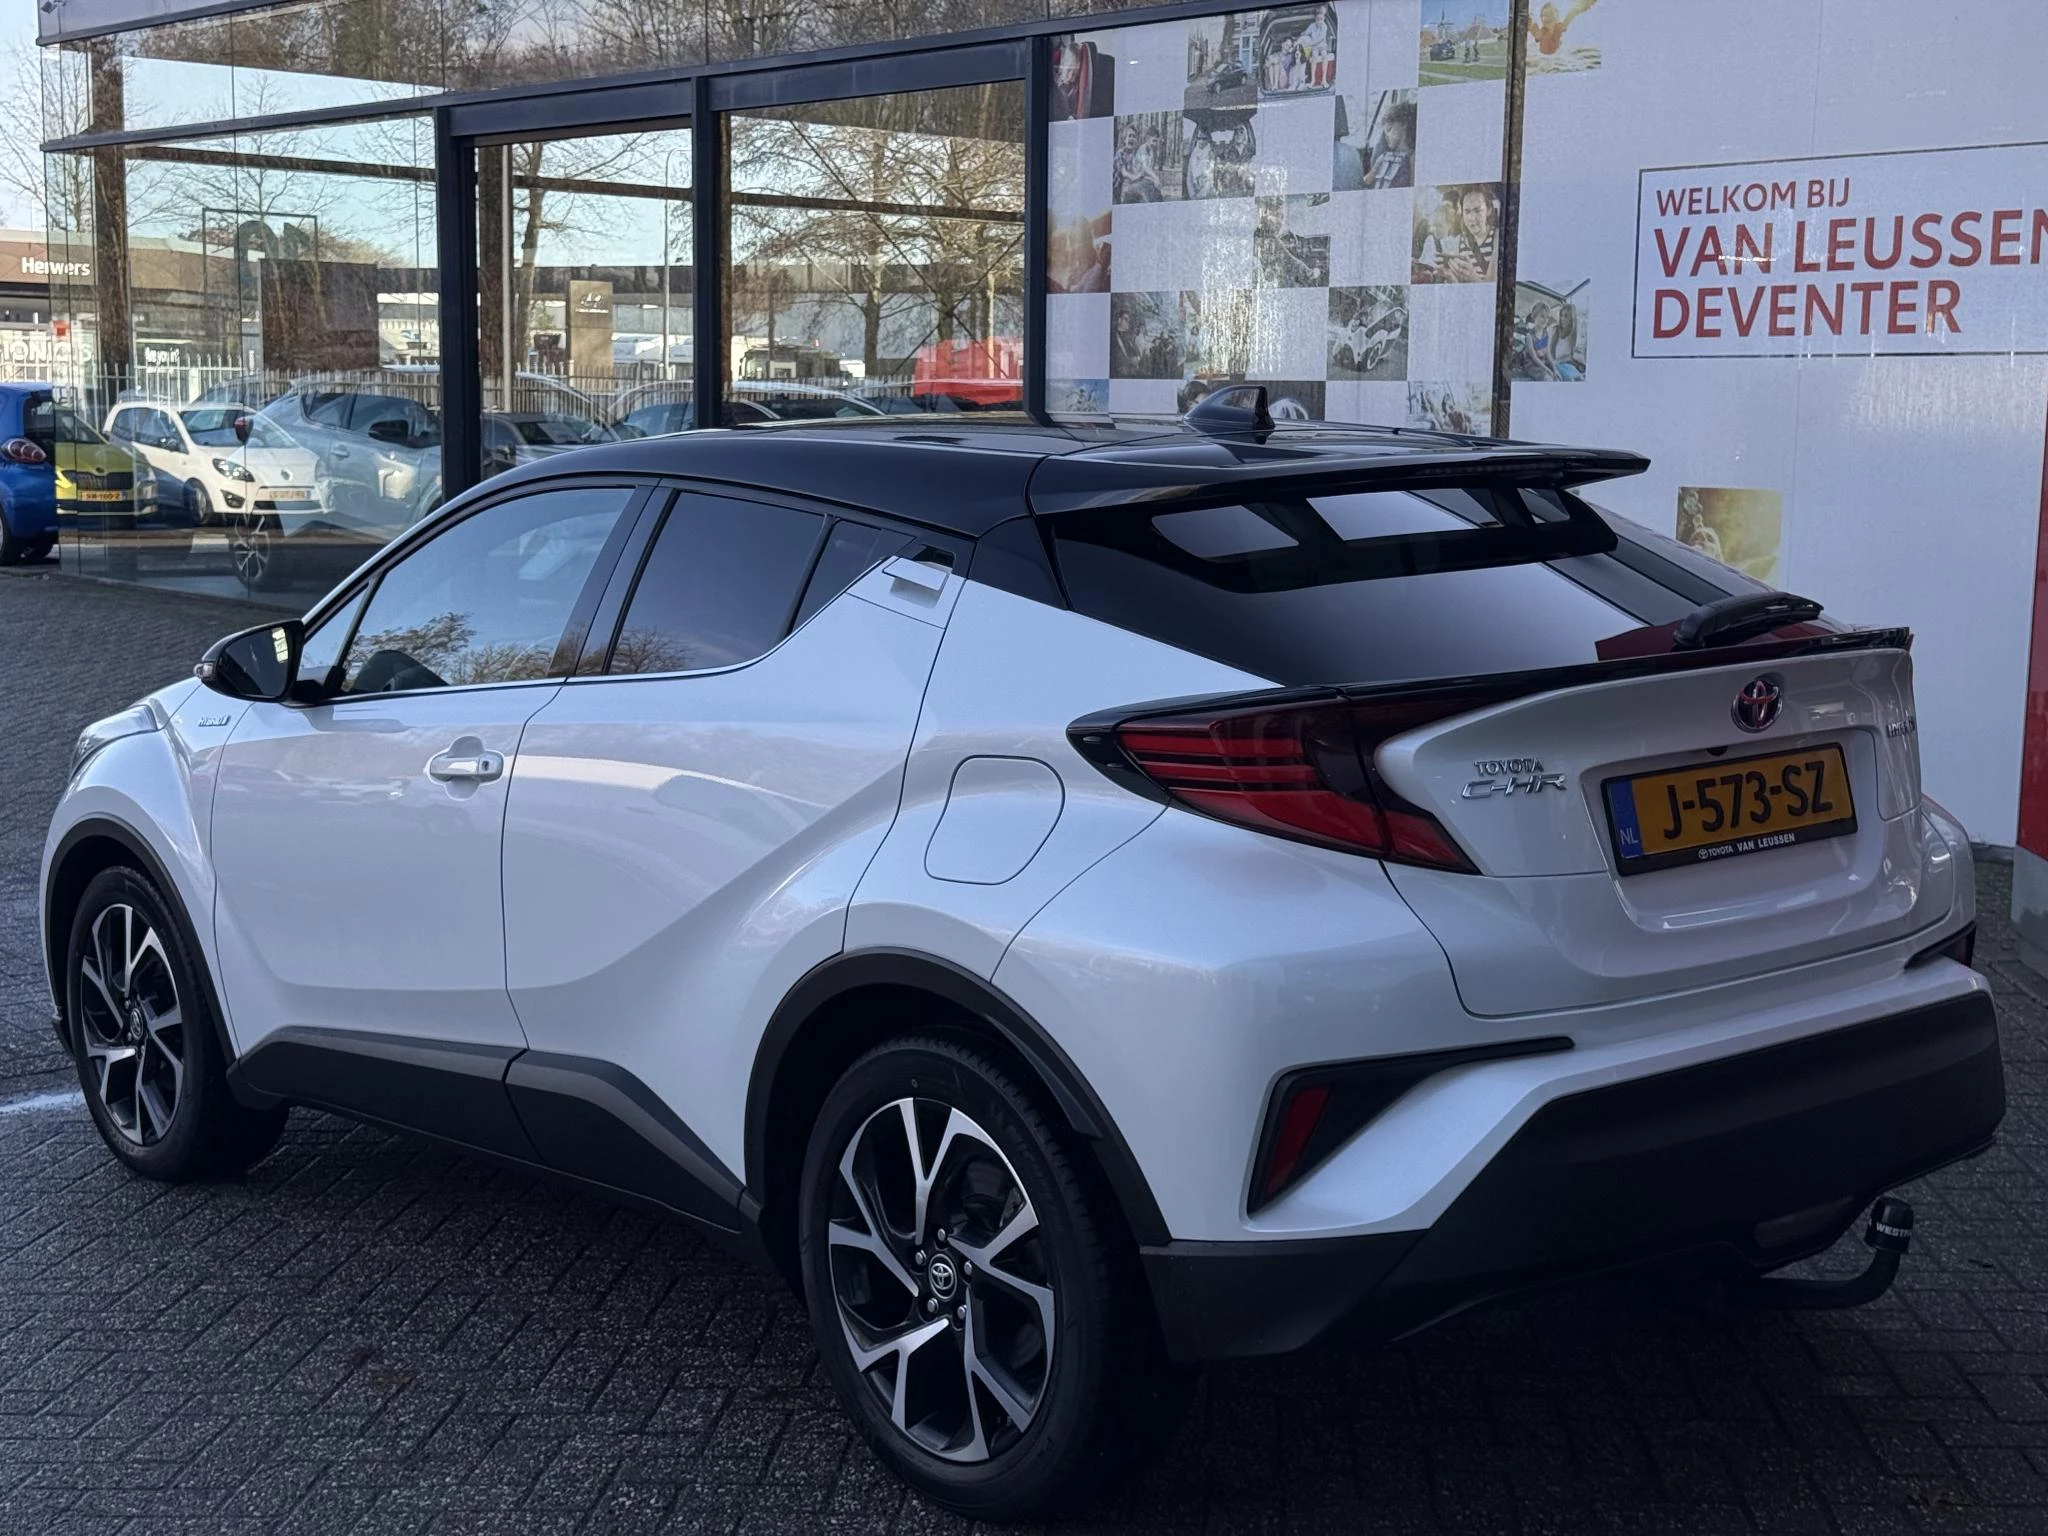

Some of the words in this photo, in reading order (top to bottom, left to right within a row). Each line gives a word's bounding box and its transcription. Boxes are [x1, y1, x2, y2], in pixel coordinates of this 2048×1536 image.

[1656, 181, 1796, 216] WELKOM
[1806, 177, 1850, 208] BIJ
[1654, 222, 1774, 278] VAN
[1653, 279, 1962, 339] DEVENTER
[1474, 757, 1544, 776] TOYOTA
[1461, 773, 1567, 800] C-HR
[1663, 760, 1833, 840] J-573-SZ
[1619, 828, 1639, 845] NL
[1708, 845, 1734, 857] TOYOTA
[1736, 839, 1755, 852] VAN
[1757, 833, 1796, 848] LEUSSEN
